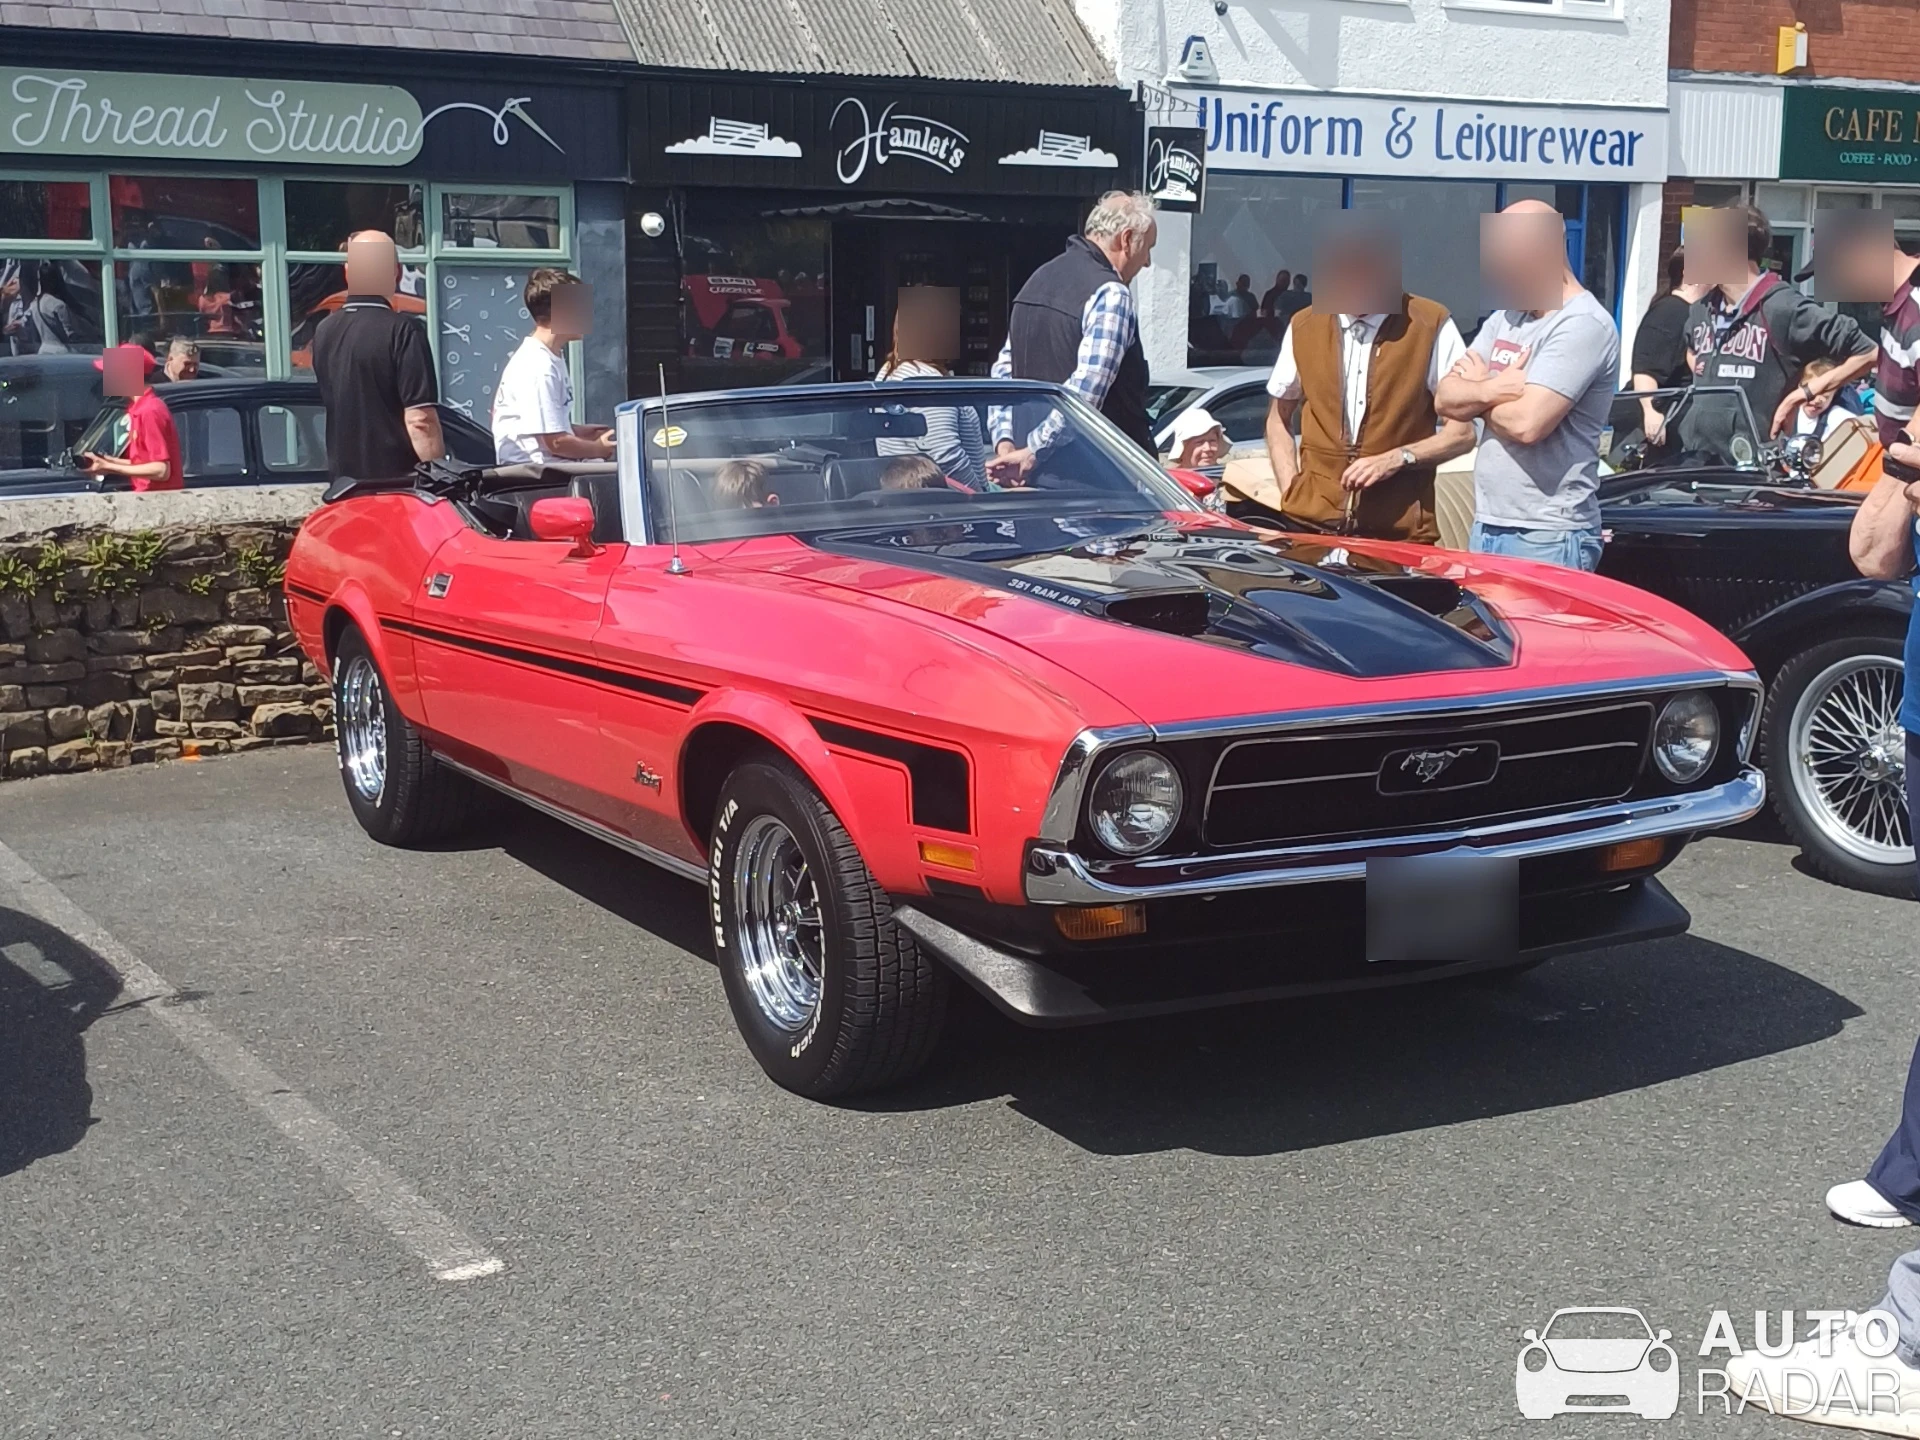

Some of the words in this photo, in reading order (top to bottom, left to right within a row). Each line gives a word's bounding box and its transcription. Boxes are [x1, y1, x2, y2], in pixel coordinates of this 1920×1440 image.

[12, 75, 228, 148] Thread
[245, 89, 423, 156] Studio
[829, 97, 965, 184] Hamlet's
[1199, 96, 1364, 159] Uniform
[1385, 106, 1417, 160] &
[1435, 108, 1645, 167] Leisurewear
[1825, 106, 1904, 143] CAFE
[1149, 138, 1200, 190] Hamlet's
[1839, 151, 1876, 165] COFFEE
[1883, 152, 1912, 166] FOOD
[1007, 578, 1031, 591] 351
[1030, 585, 1061, 600] RAM
[1058, 595, 1082, 608] AIR
[711, 836, 726, 948] Radial
[719, 798, 739, 833] T/A
